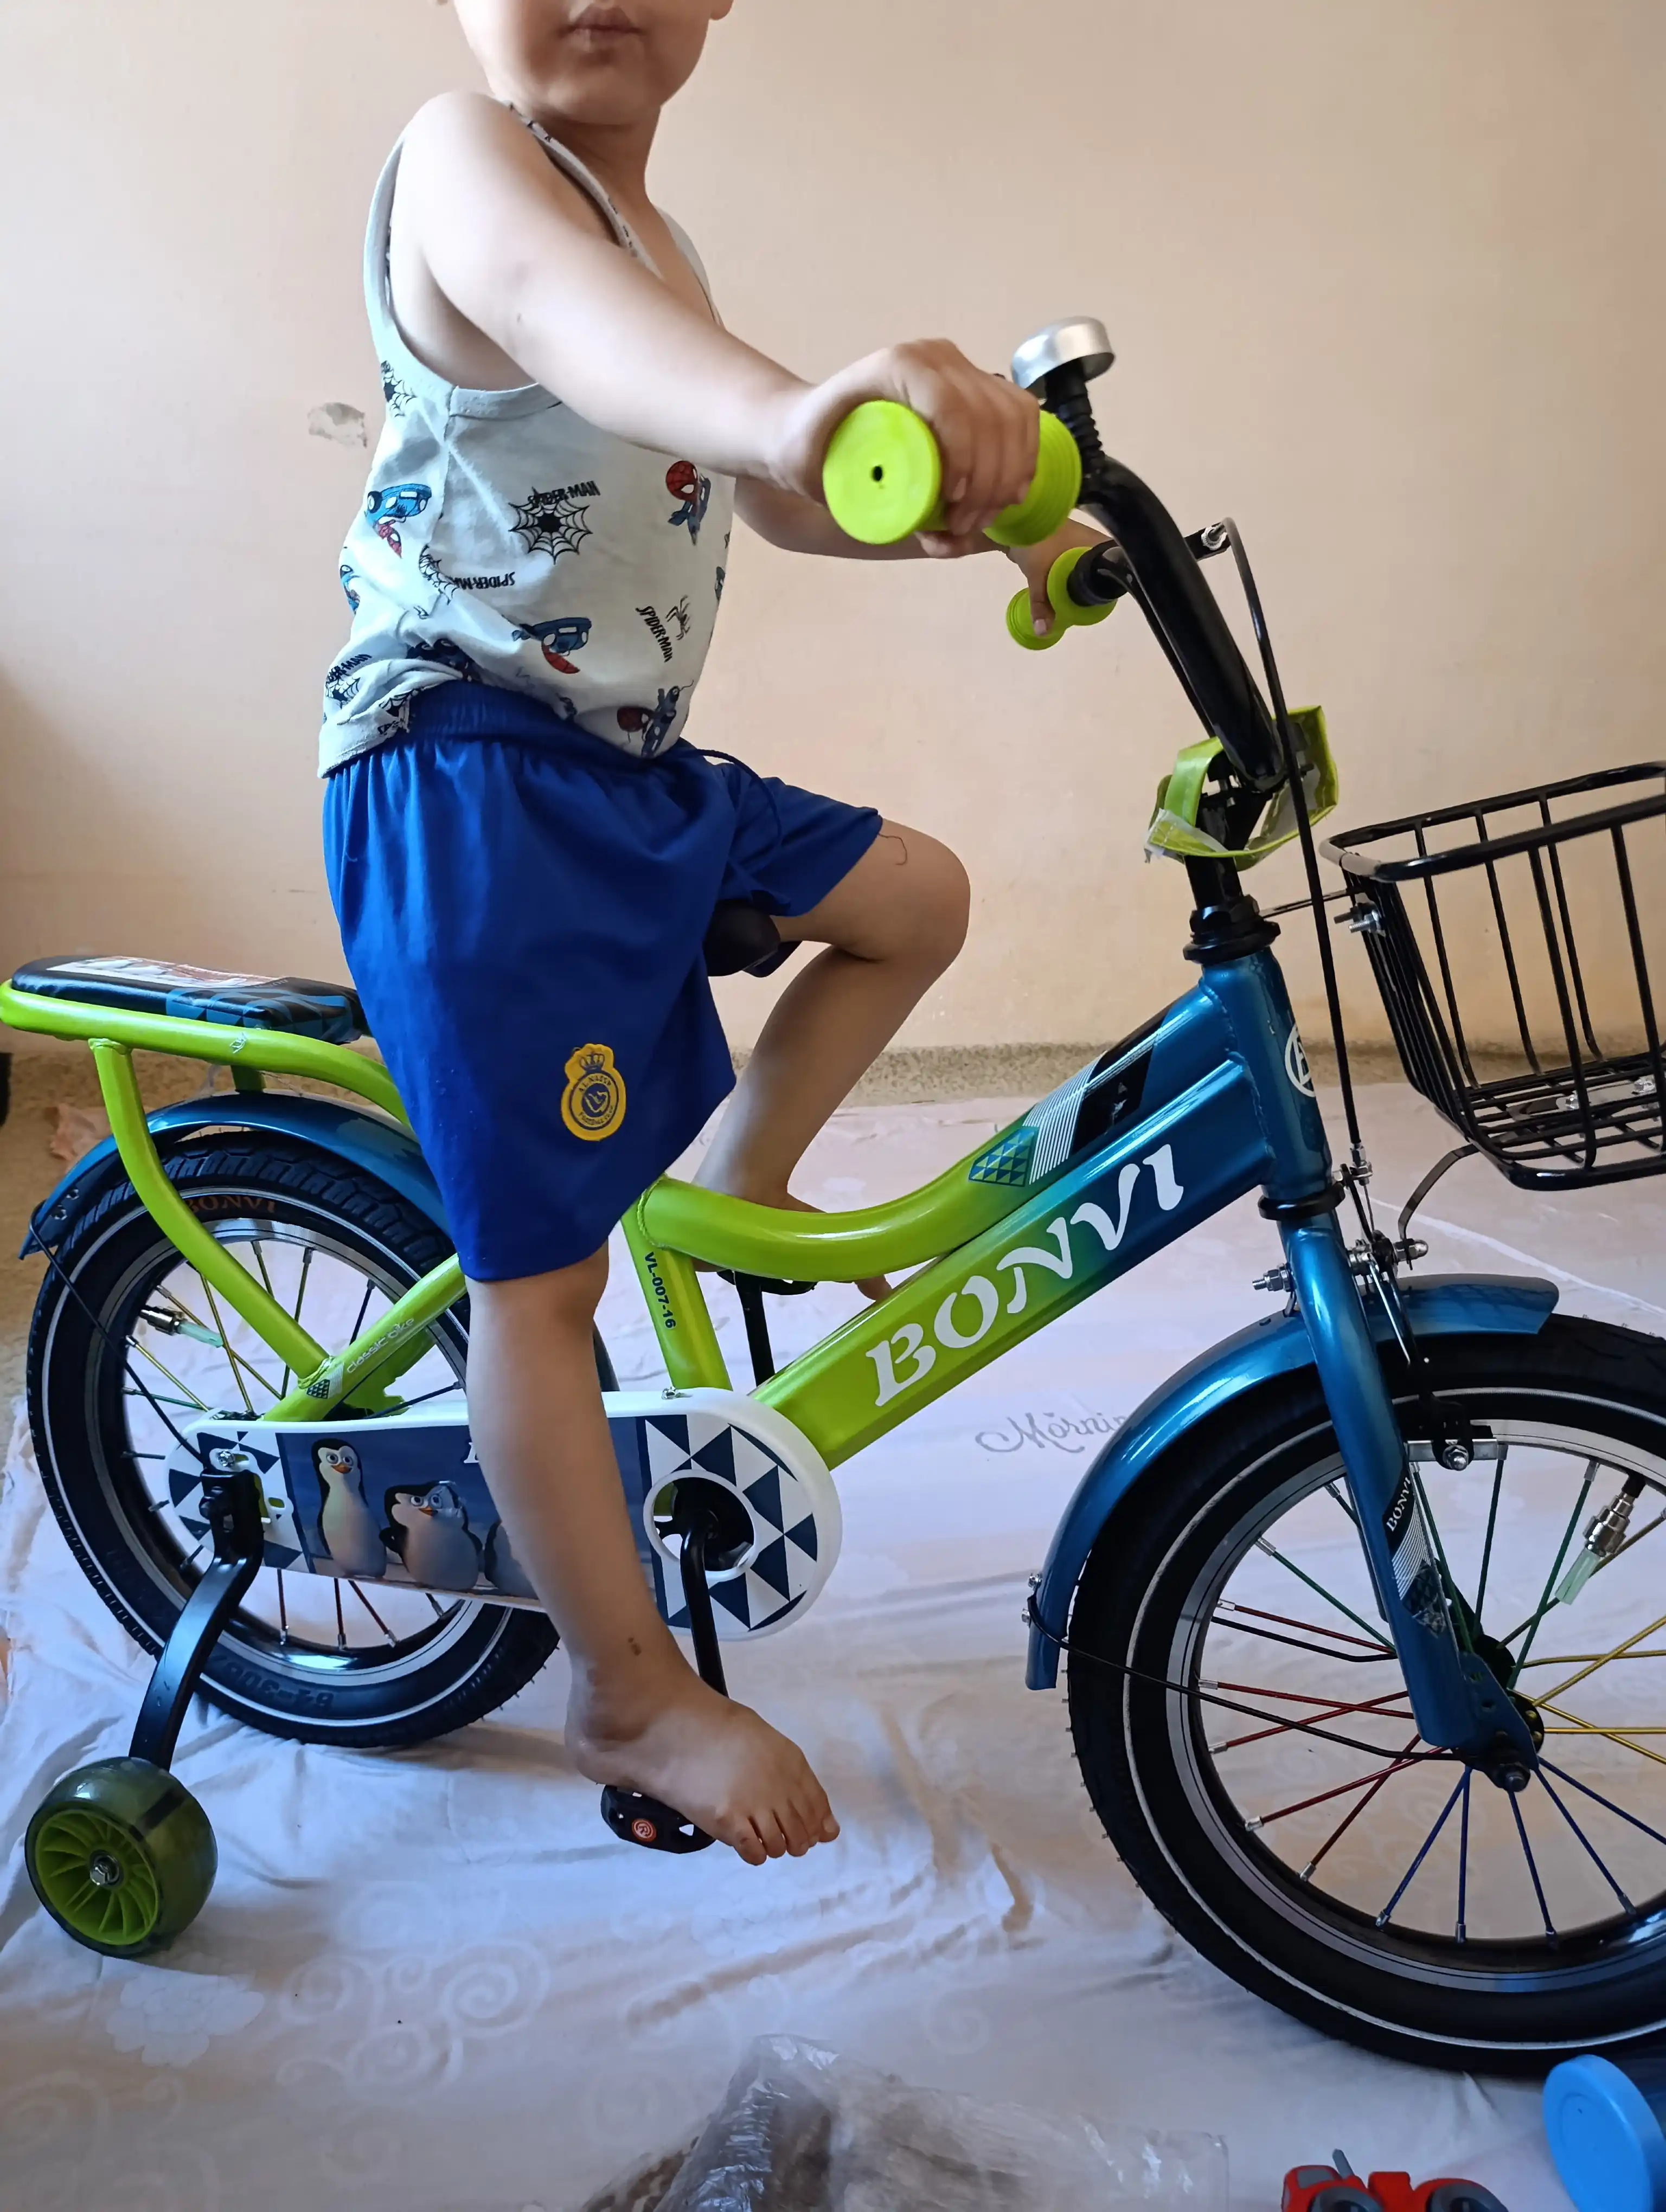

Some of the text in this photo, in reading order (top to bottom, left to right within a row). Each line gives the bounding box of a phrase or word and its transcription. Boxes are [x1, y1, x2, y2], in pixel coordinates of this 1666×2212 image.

[453, 571, 515, 590] SPIDER-MA
[635, 606, 672, 663] SPIDER-MAN
[645, 1251, 676, 1328] VL-007-16
[866, 1144, 1183, 1406] BONVI
[347, 1337, 389, 1373] classic
[1386, 1477, 1411, 1532] BONVI
